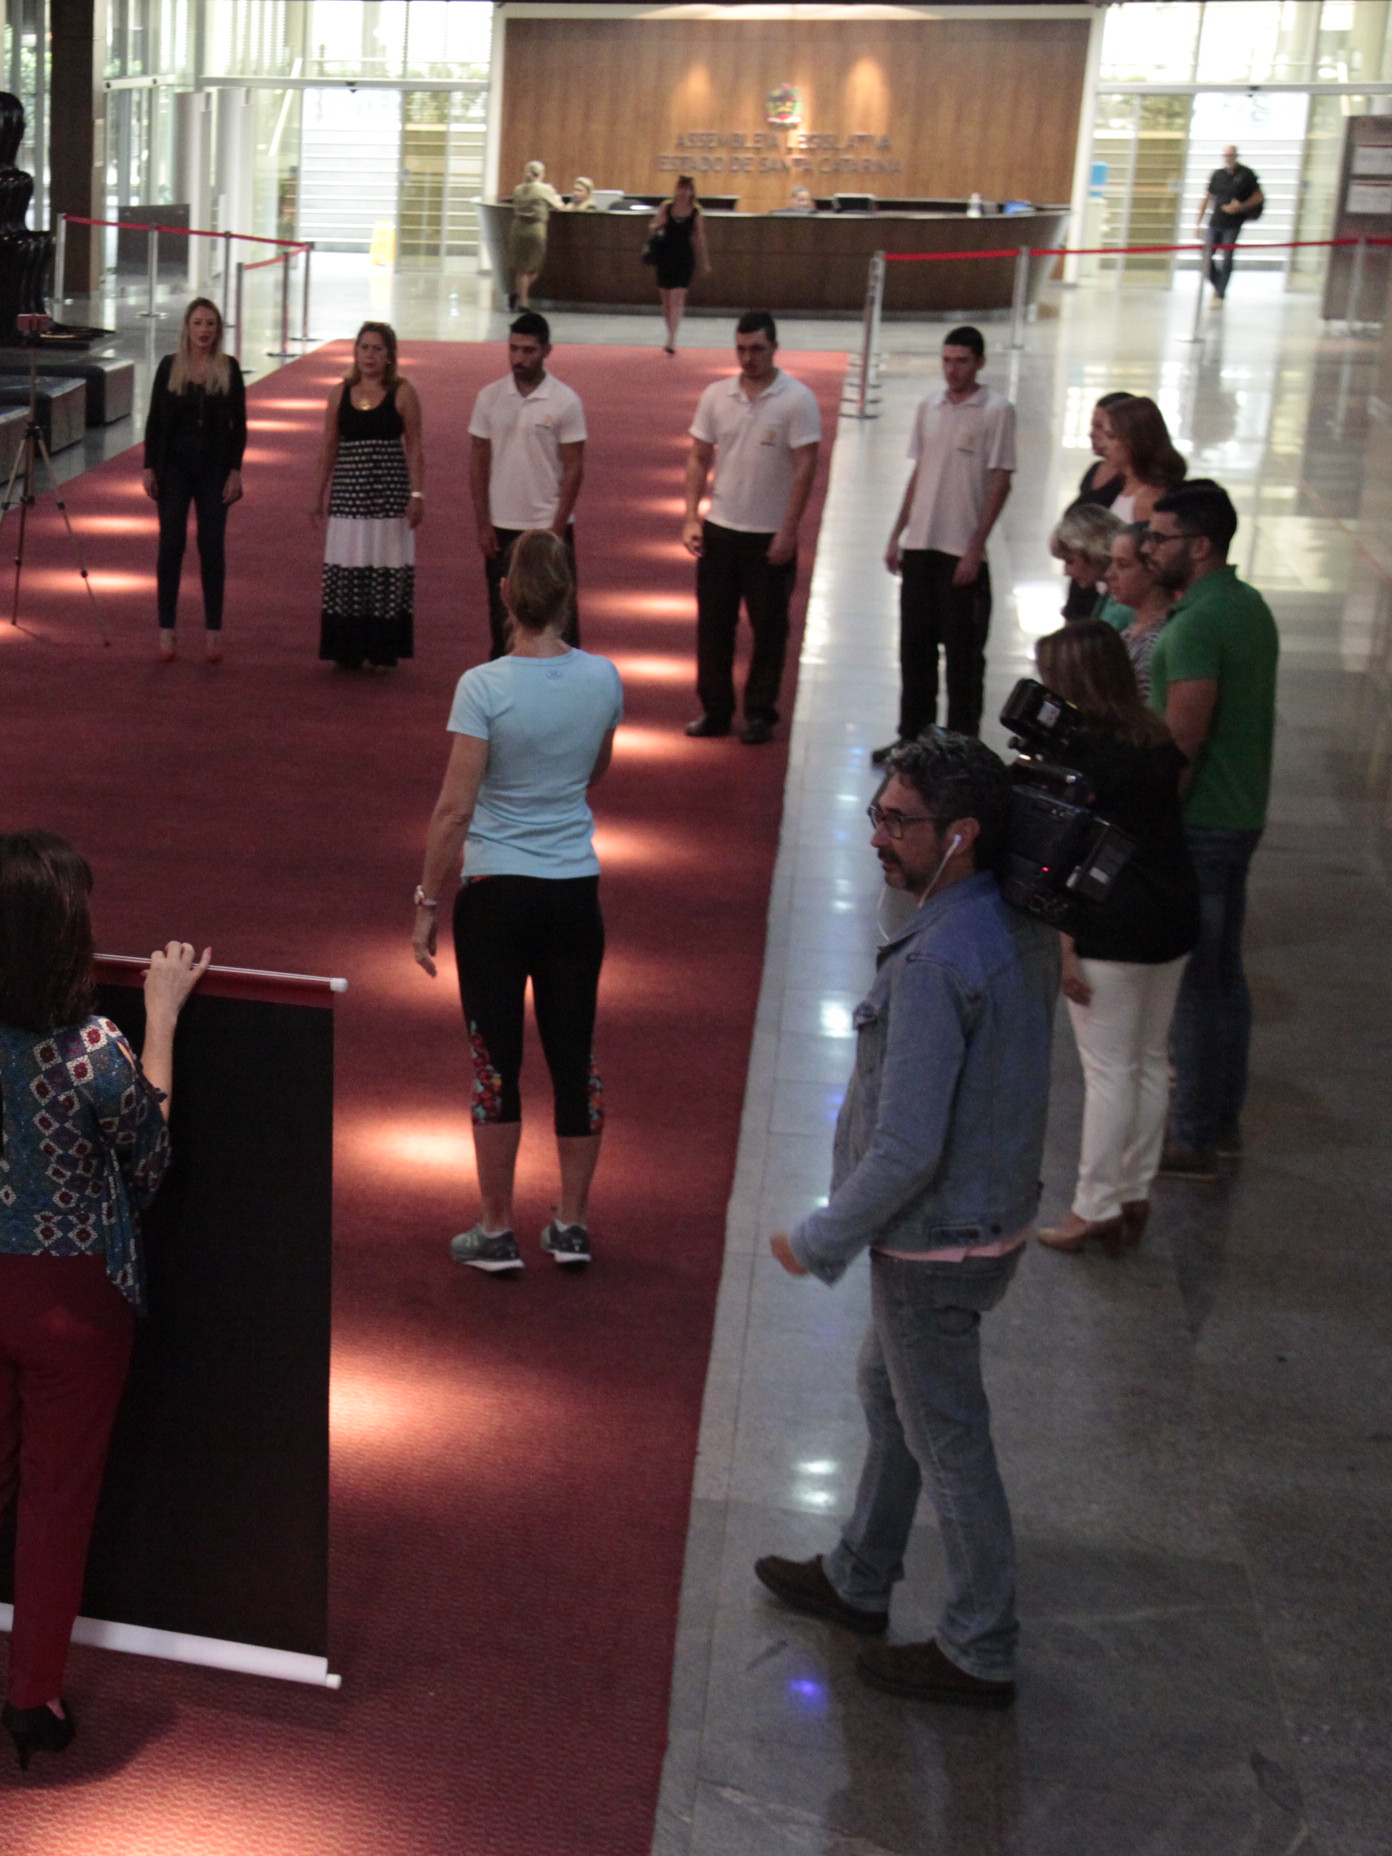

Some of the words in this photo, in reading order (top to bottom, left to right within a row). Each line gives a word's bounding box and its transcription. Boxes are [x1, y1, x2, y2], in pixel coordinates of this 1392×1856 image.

[659, 155, 724, 172] ESTADO
[730, 156, 754, 173] DE
[760, 157, 813, 174] SANTA
[820, 158, 902, 174] CATARINA
